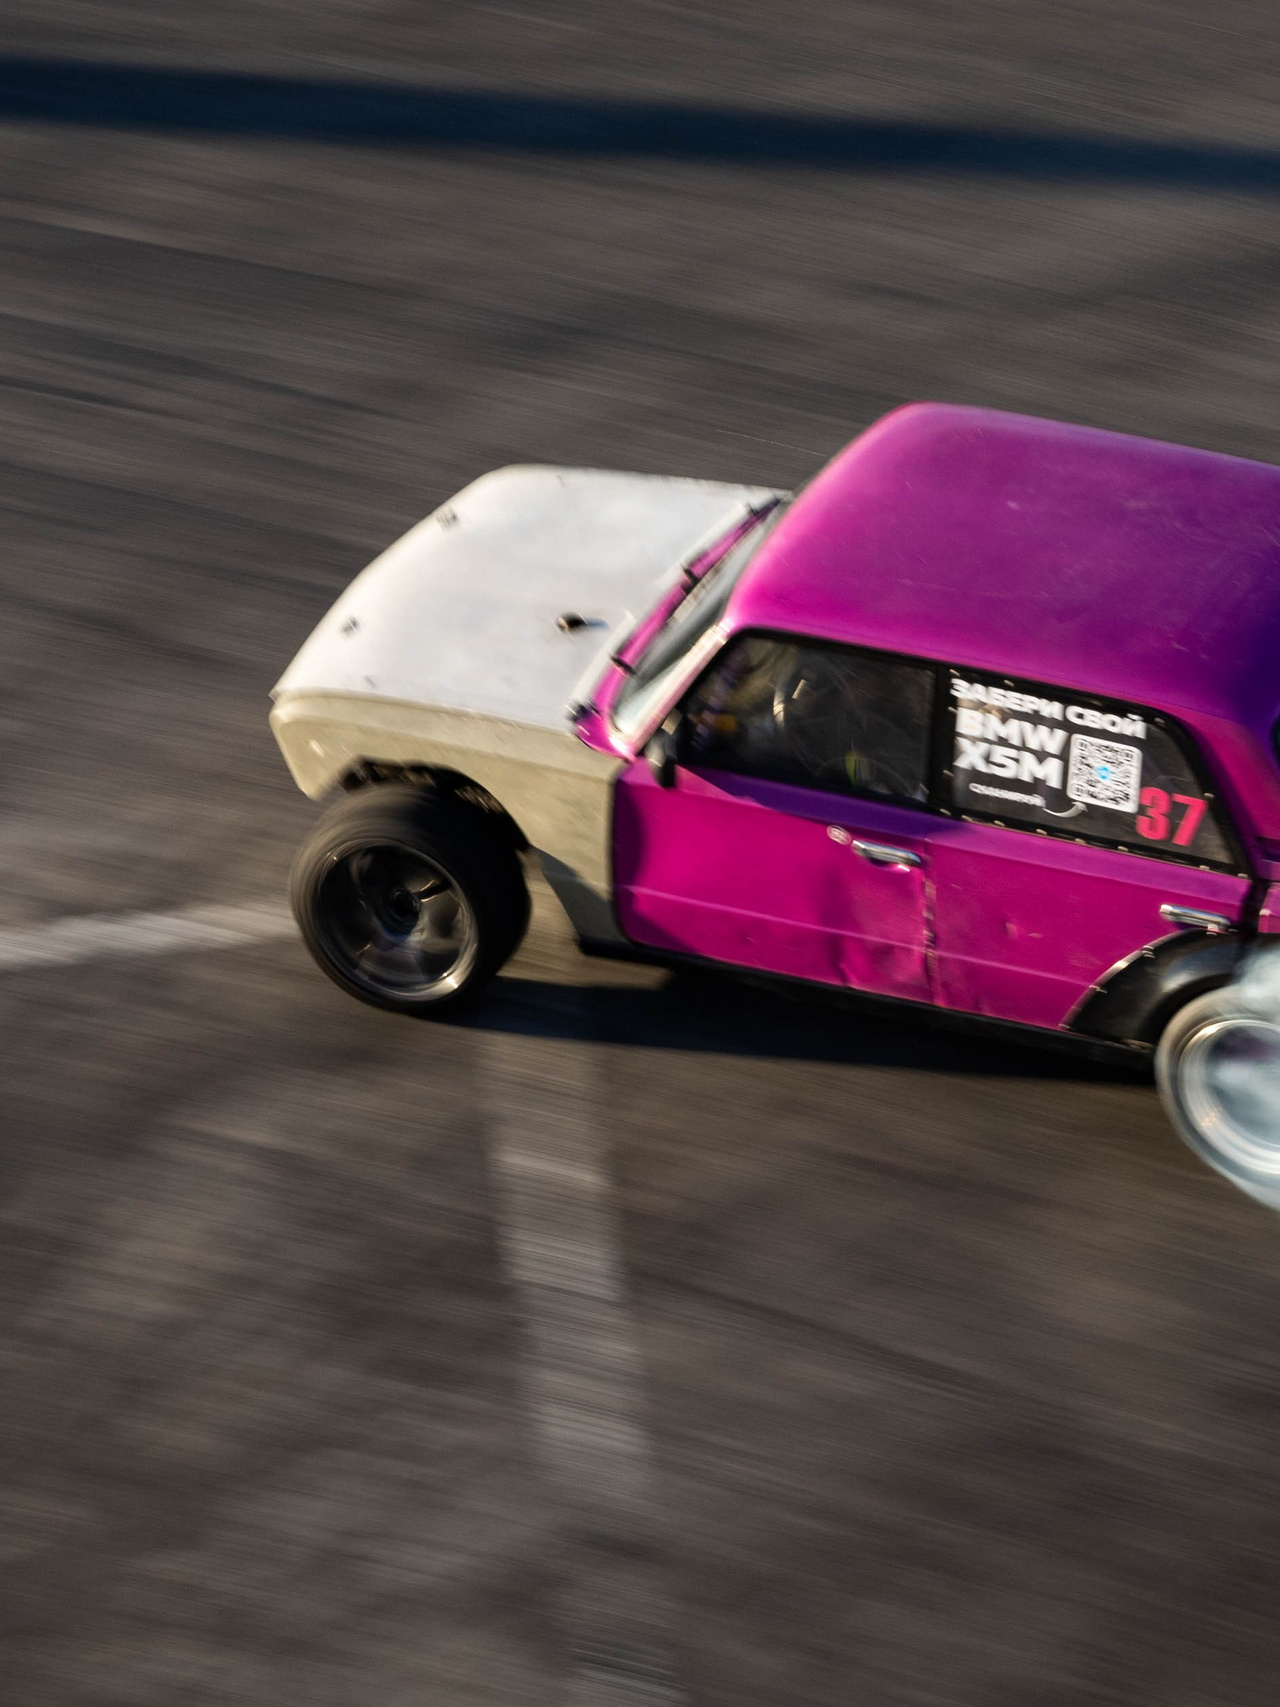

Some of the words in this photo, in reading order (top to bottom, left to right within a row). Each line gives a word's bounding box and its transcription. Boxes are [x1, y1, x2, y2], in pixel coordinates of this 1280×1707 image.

[950, 678, 1065, 722] ЗАБЕРИ
[1064, 705, 1147, 740] СВОЙ
[955, 707, 1069, 755] BMW
[954, 737, 1064, 789] X5M
[1136, 787, 1208, 846] 37
